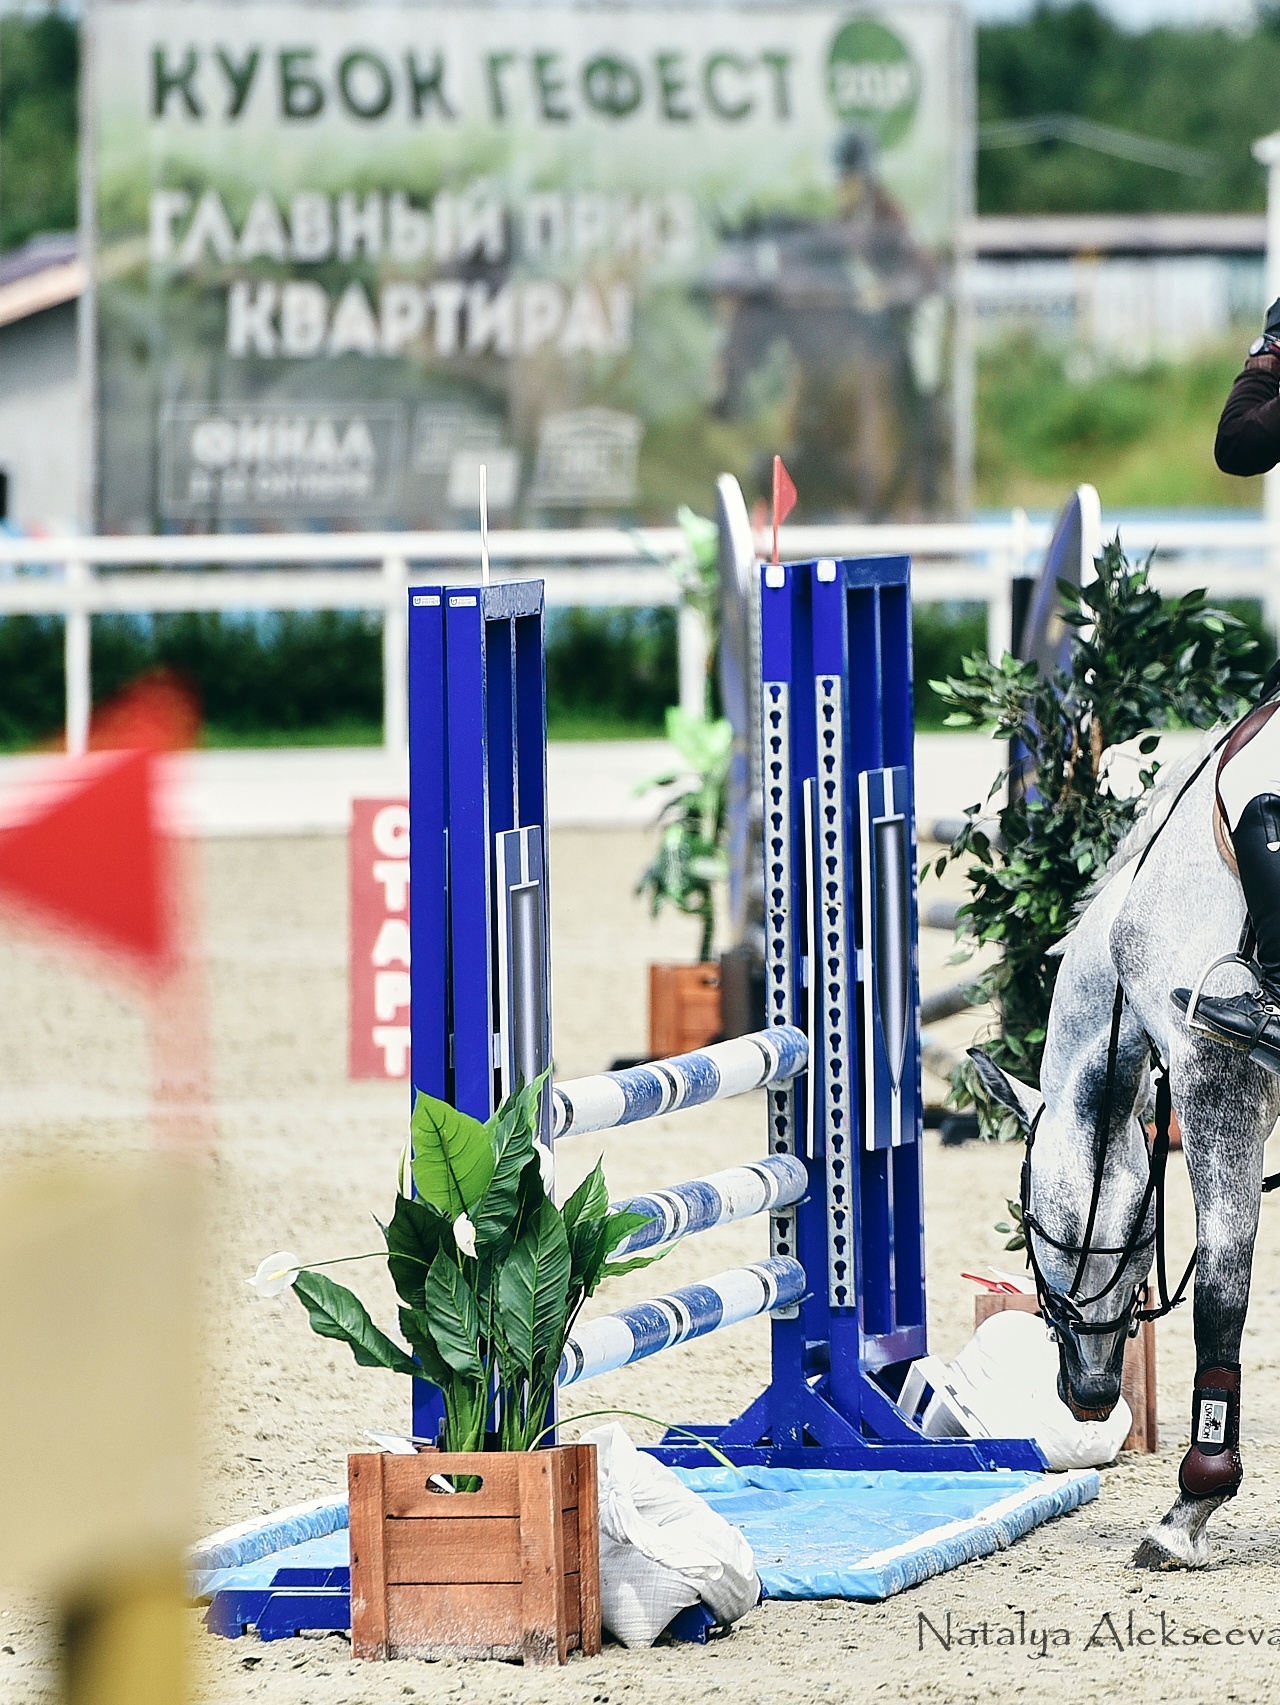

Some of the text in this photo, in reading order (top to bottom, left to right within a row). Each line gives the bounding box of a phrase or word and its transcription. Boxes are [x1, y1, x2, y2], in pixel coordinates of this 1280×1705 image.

[150, 43, 796, 123] КУБОК ГЕФЕСТ
[149, 180, 504, 264] ГЛАВНЫЙ
[227, 283, 634, 360] КВАРТИРА!
[372, 804, 410, 1077] СТАРТ
